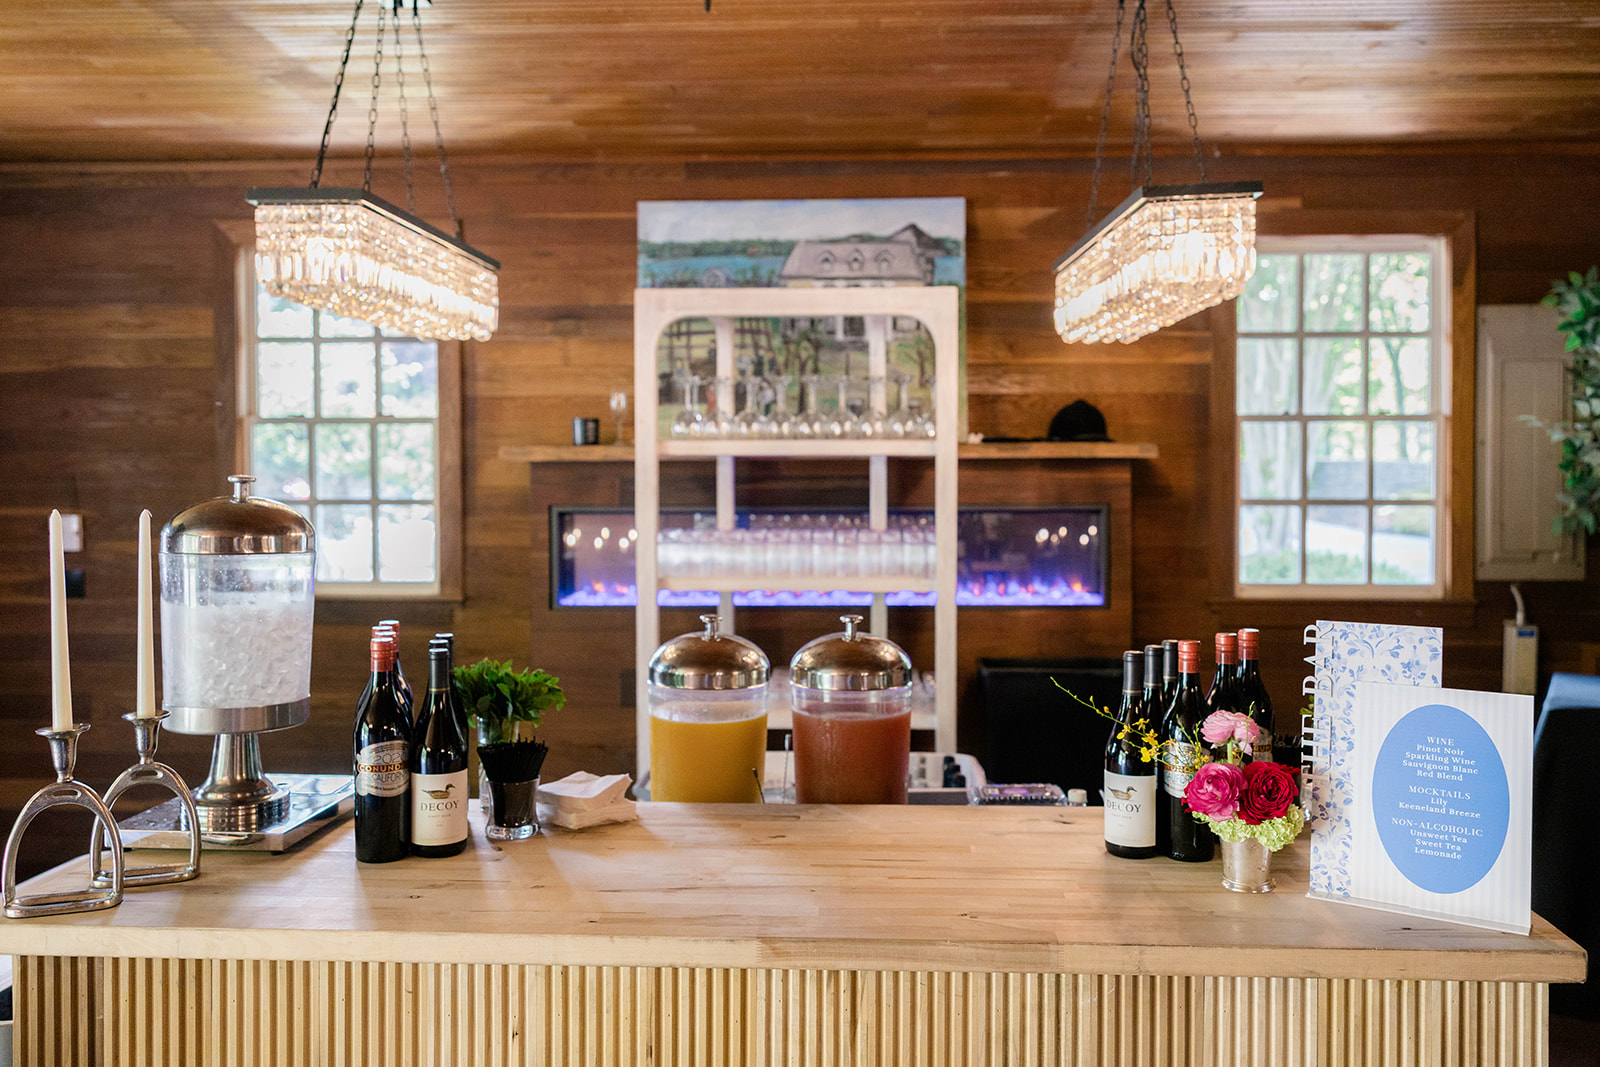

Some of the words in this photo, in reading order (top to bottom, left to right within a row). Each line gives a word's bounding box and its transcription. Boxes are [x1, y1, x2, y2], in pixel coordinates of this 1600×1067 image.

[1303, 623, 1335, 697] BAR
[1427, 735, 1455, 747] WINE
[1301, 714, 1333, 784] THE
[1416, 744, 1440, 753] Pinot
[1444, 747, 1464, 756] Noir
[1405, 751, 1449, 764] Sparkling
[1451, 756, 1476, 766] Wine
[1402, 759, 1450, 771] Sauvignon
[1453, 765, 1479, 775] Blanc
[1417, 769, 1434, 778] Red
[1436, 772, 1463, 781] Blend
[1409, 785, 1471, 800] MOCKTAILS
[420, 800, 458, 812] DECOY
[1106, 799, 1141, 813] DECOY
[1431, 797, 1448, 807] Lily
[1399, 801, 1446, 814] Keeneland
[1449, 808, 1481, 819] Breeze
[1391, 817, 1484, 837] NON-ALCOHOLIC
[1410, 829, 1448, 841] Unsweet
[1451, 835, 1468, 843] Tea
[1415, 838, 1442, 848] Sweet
[1445, 842, 1462, 851] Tea
[1415, 846, 1462, 860] Lemonade
